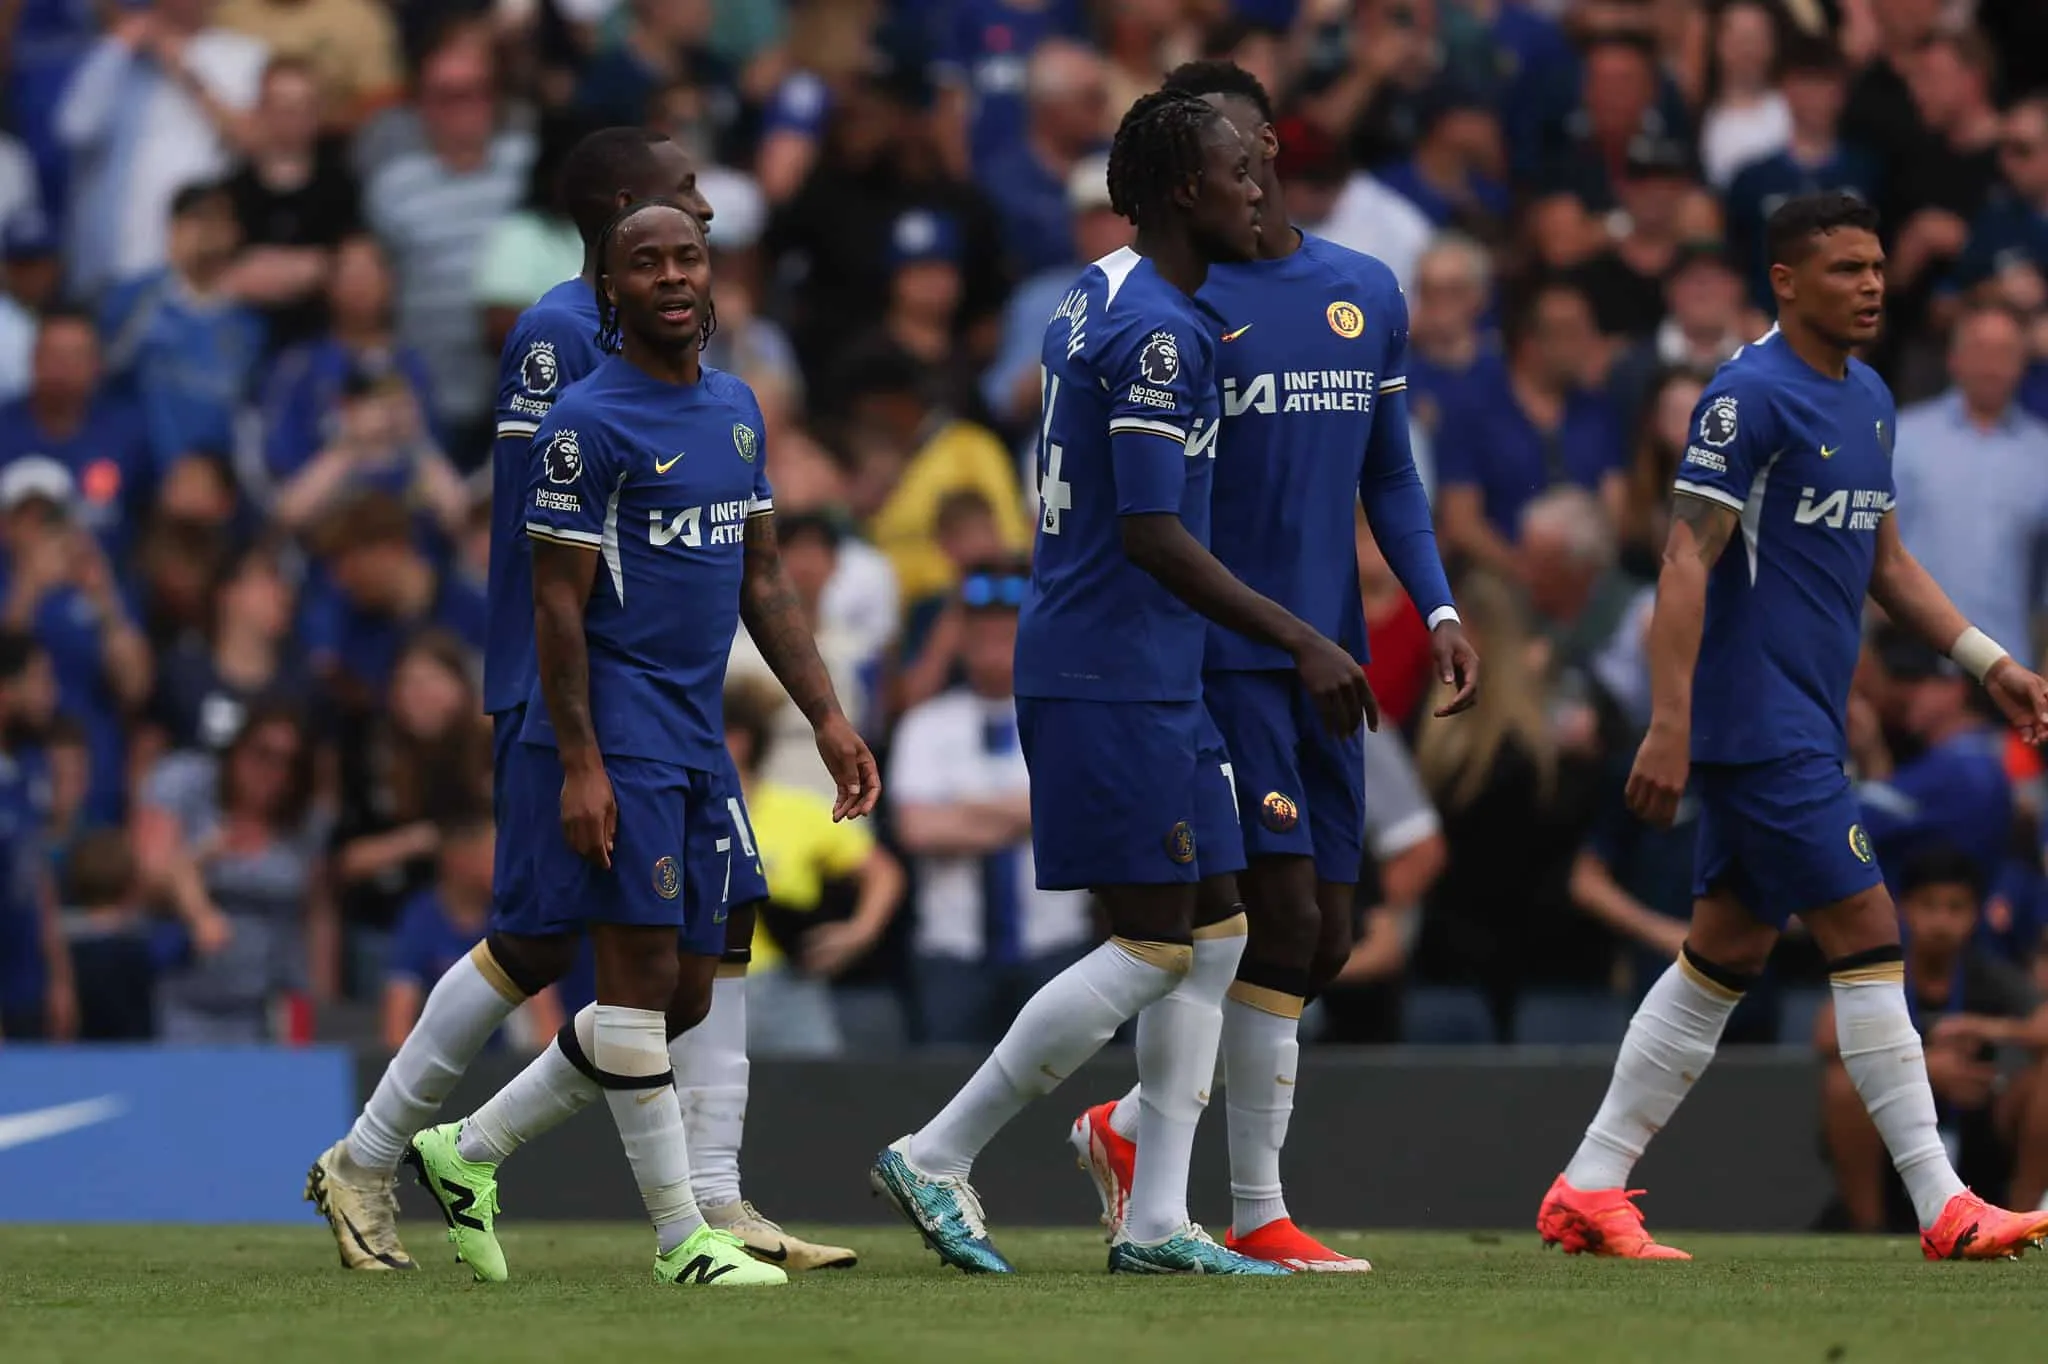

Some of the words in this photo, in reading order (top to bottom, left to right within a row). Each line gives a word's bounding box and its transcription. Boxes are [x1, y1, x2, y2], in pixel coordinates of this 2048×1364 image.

[1284, 370, 1375, 391] INFINITE
[1130, 384, 1146, 396] No
[1146, 388, 1174, 401] room
[525, 399, 552, 410] room
[1128, 393, 1144, 403] for
[1144, 397, 1177, 411] racism
[1283, 392, 1371, 413] ATHLETE
[536, 487, 549, 499] No
[550, 492, 577, 503] room
[536, 497, 549, 507] for
[549, 501, 581, 513] racism
